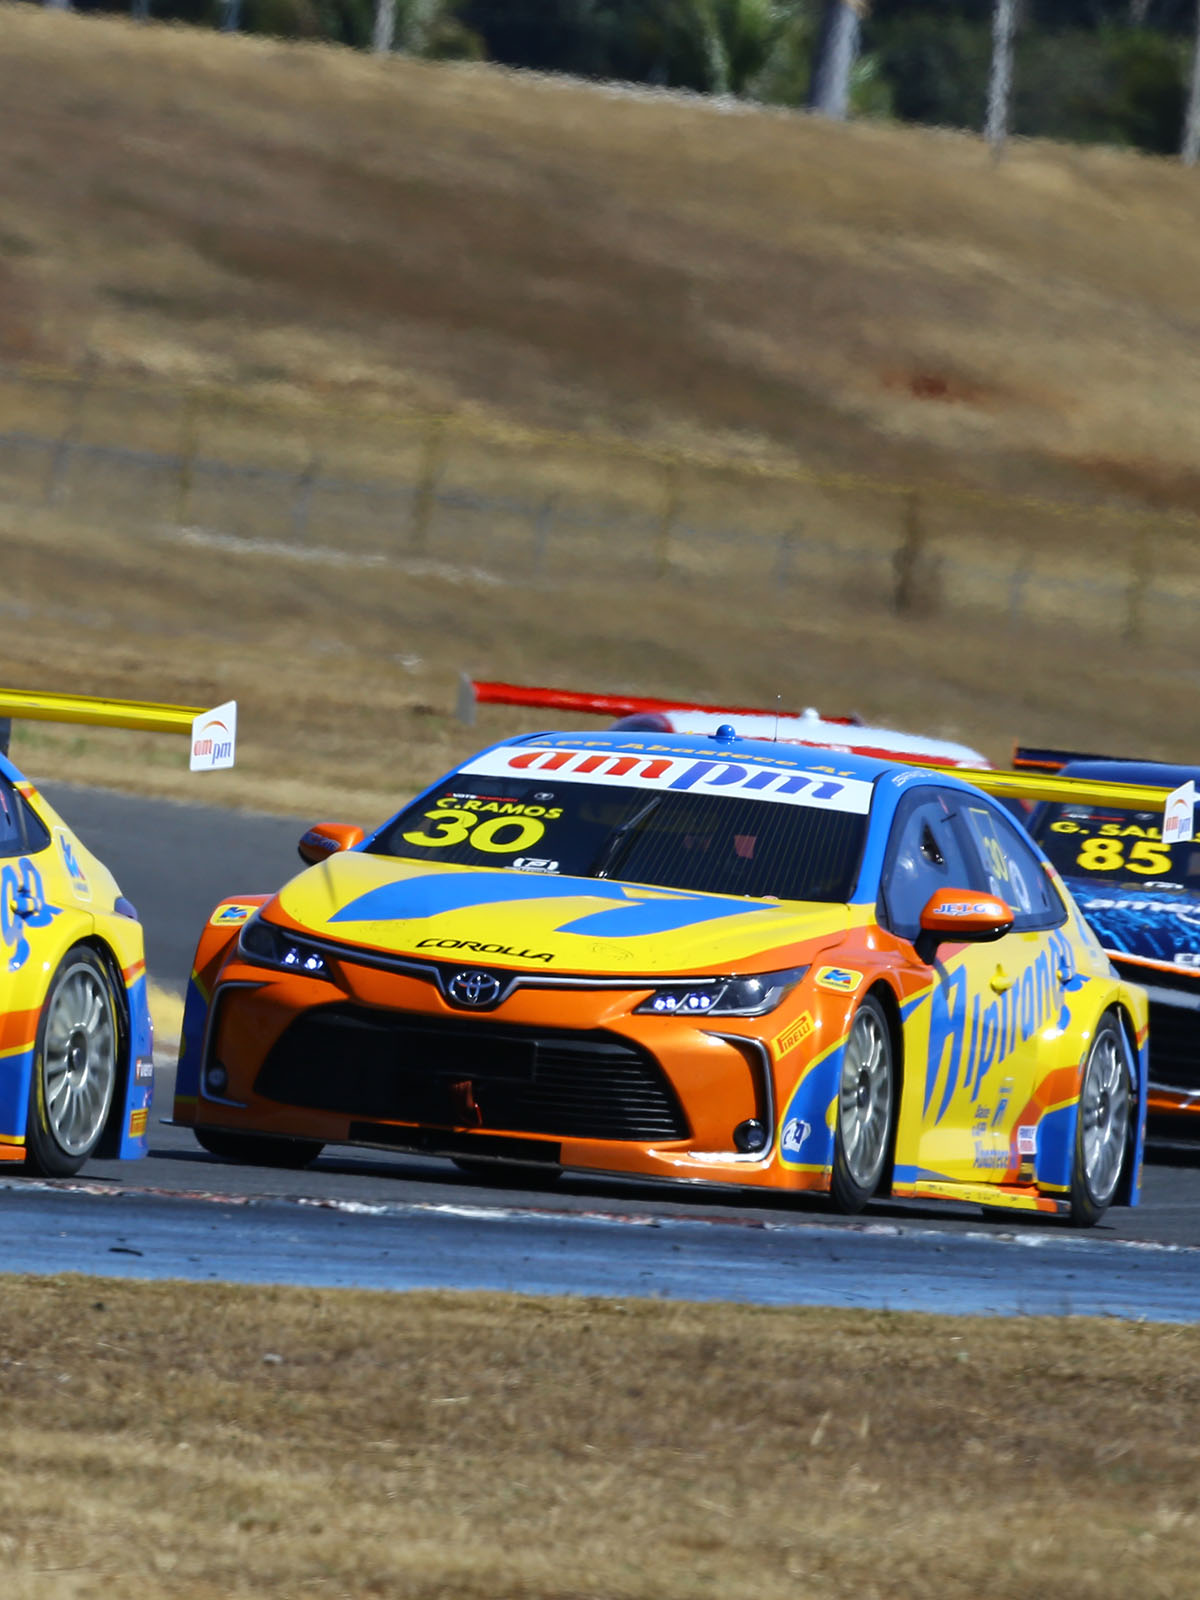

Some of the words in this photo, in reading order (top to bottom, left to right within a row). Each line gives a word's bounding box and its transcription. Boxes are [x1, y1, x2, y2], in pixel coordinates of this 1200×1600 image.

[436, 798, 563, 819] C.RAMOS
[402, 809, 545, 853] 30
[1051, 822, 1090, 834] G.
[1076, 838, 1172, 875] 85
[416, 938, 555, 963] COROLLA
[776, 1015, 810, 1054] PIRELLI
[963, 929, 1091, 1103] Ipiranga
